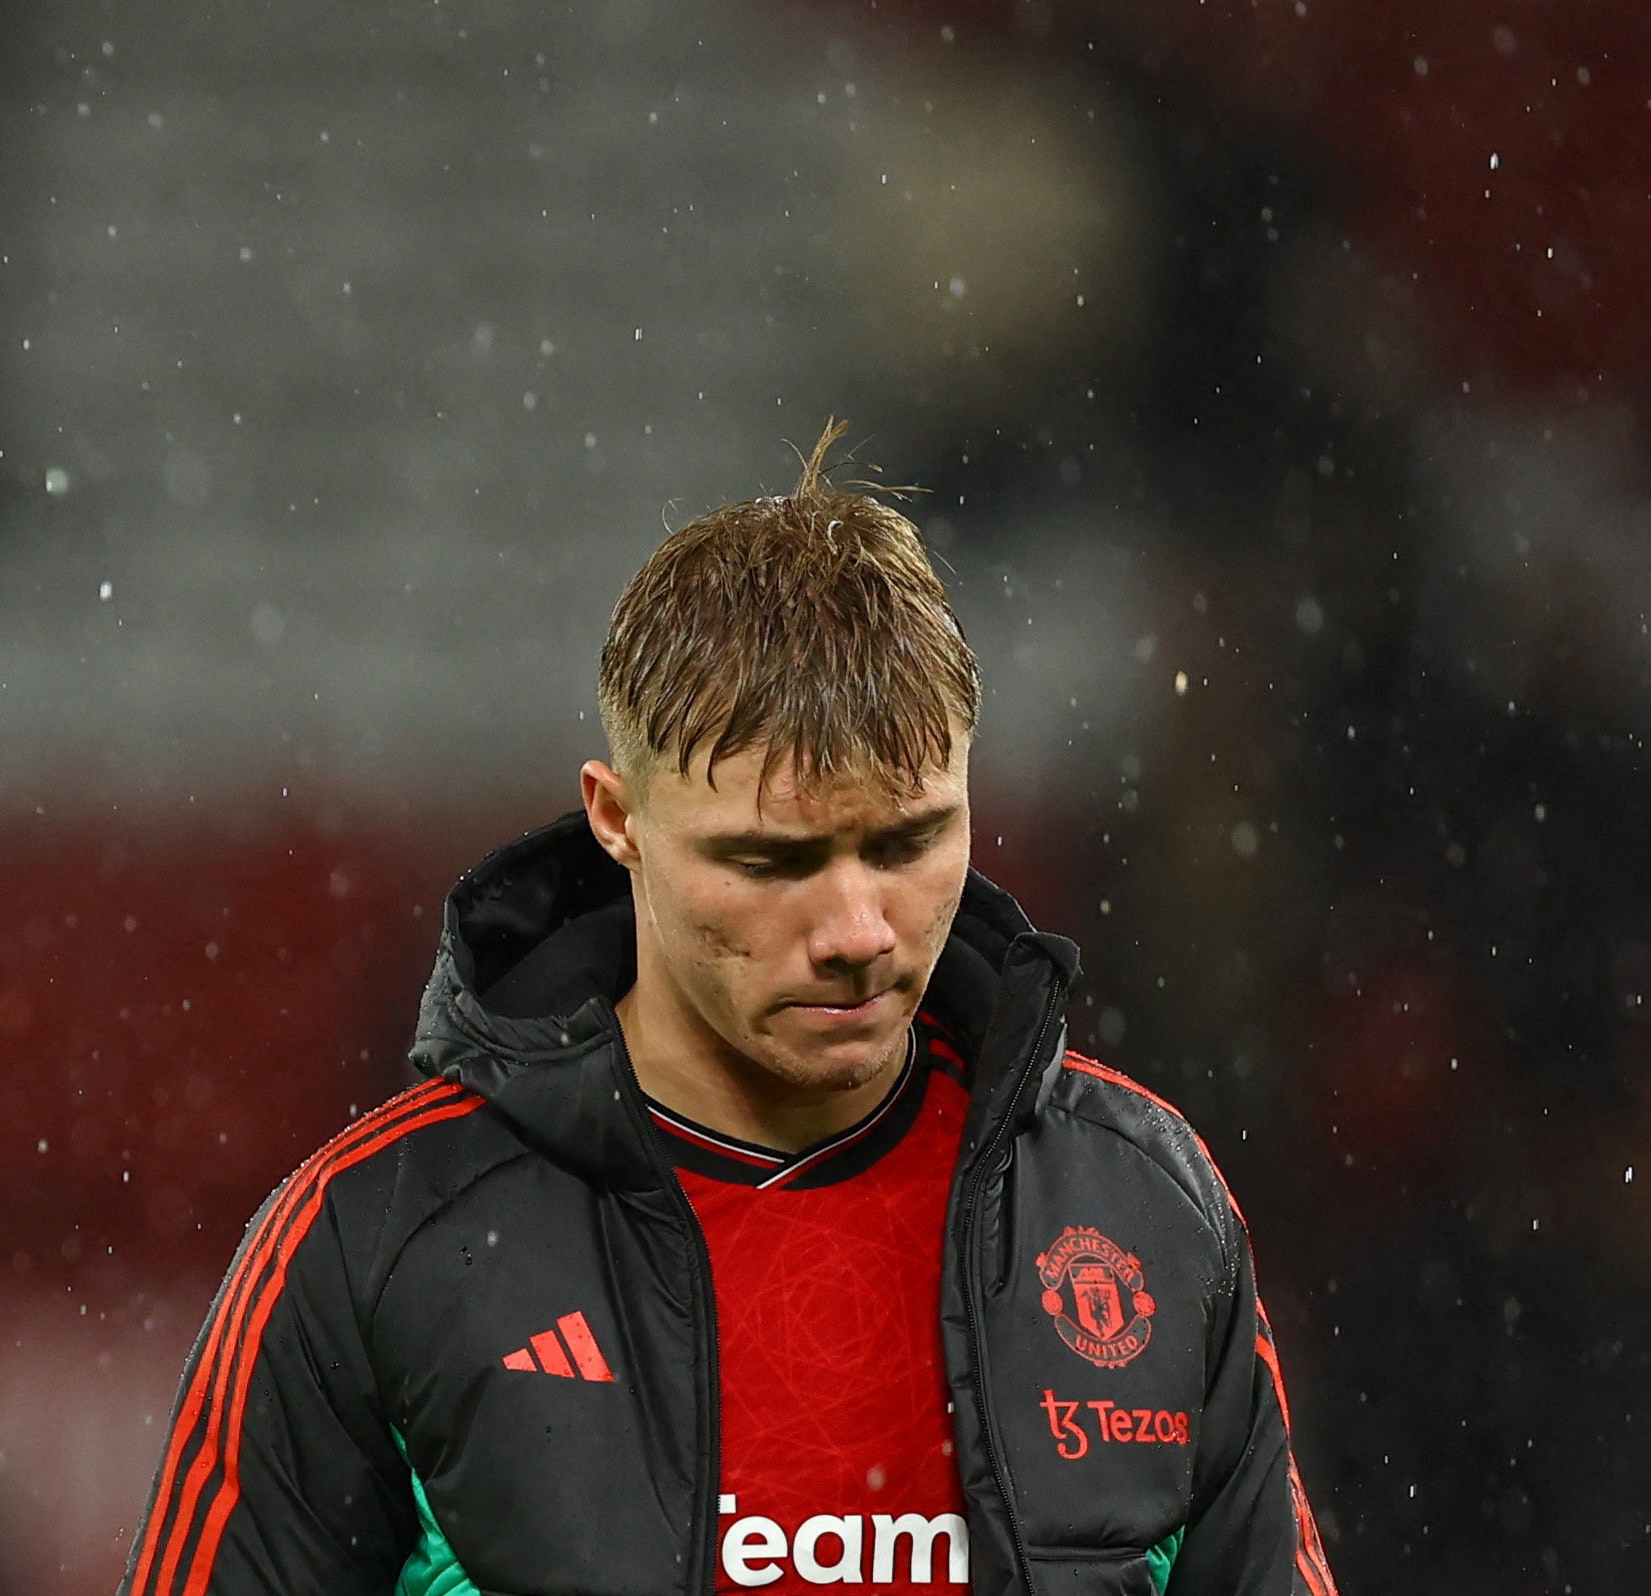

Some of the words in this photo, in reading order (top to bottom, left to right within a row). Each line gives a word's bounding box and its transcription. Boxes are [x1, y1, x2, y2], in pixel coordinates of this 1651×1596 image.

[1045, 1237, 1136, 1282] MANCHESTER
[1075, 1334, 1139, 1359] UNITED
[1086, 1400, 1190, 1446] Tezos
[718, 1493, 970, 1587] eam
